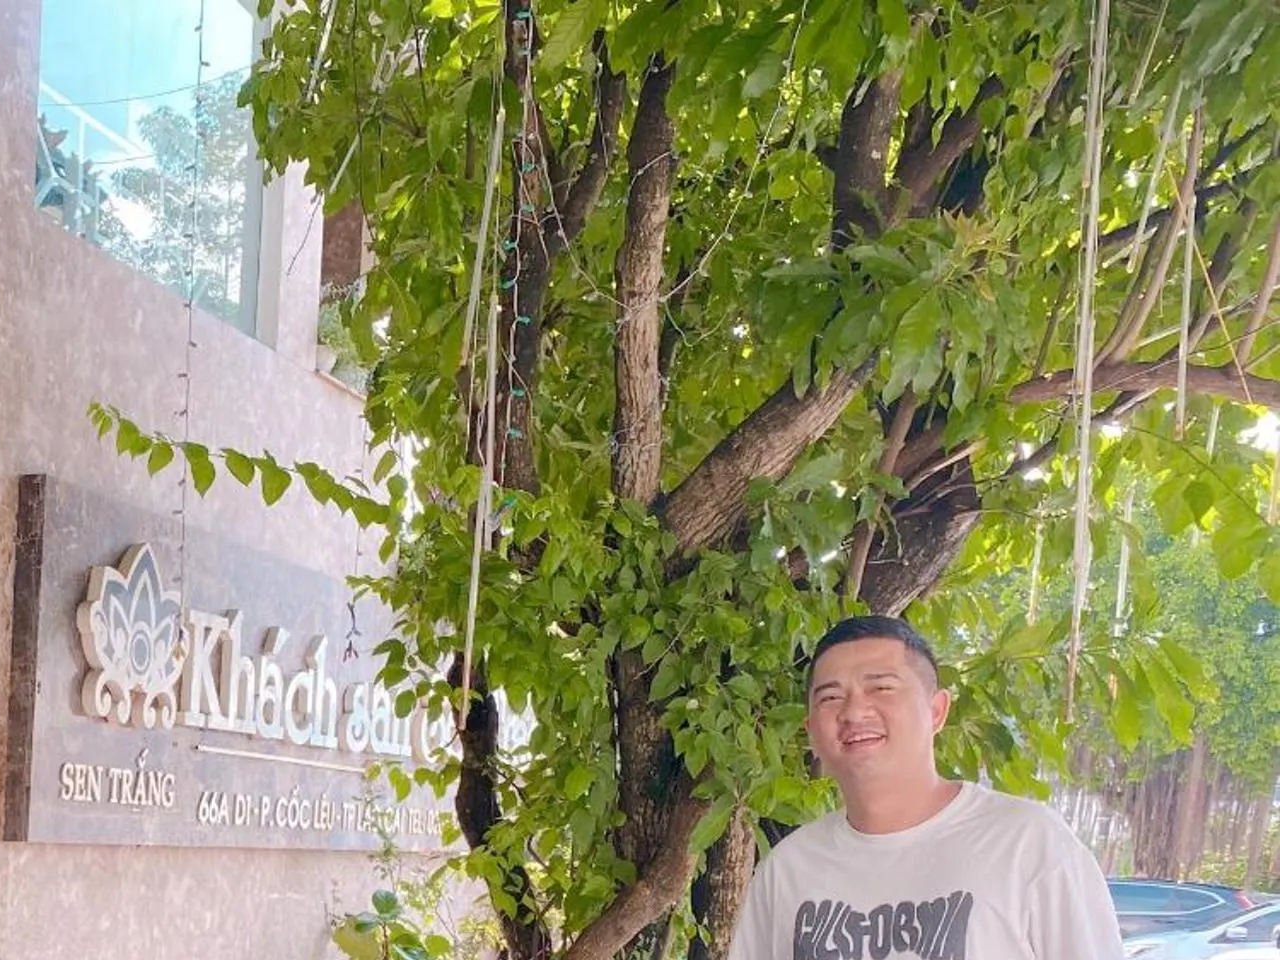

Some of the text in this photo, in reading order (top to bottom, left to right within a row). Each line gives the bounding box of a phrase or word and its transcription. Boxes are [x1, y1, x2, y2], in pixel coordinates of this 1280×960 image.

[184, 608, 339, 750] Khách
[60, 747, 176, 807] SEN TRẮNG
[198, 791, 229, 826] 66A
